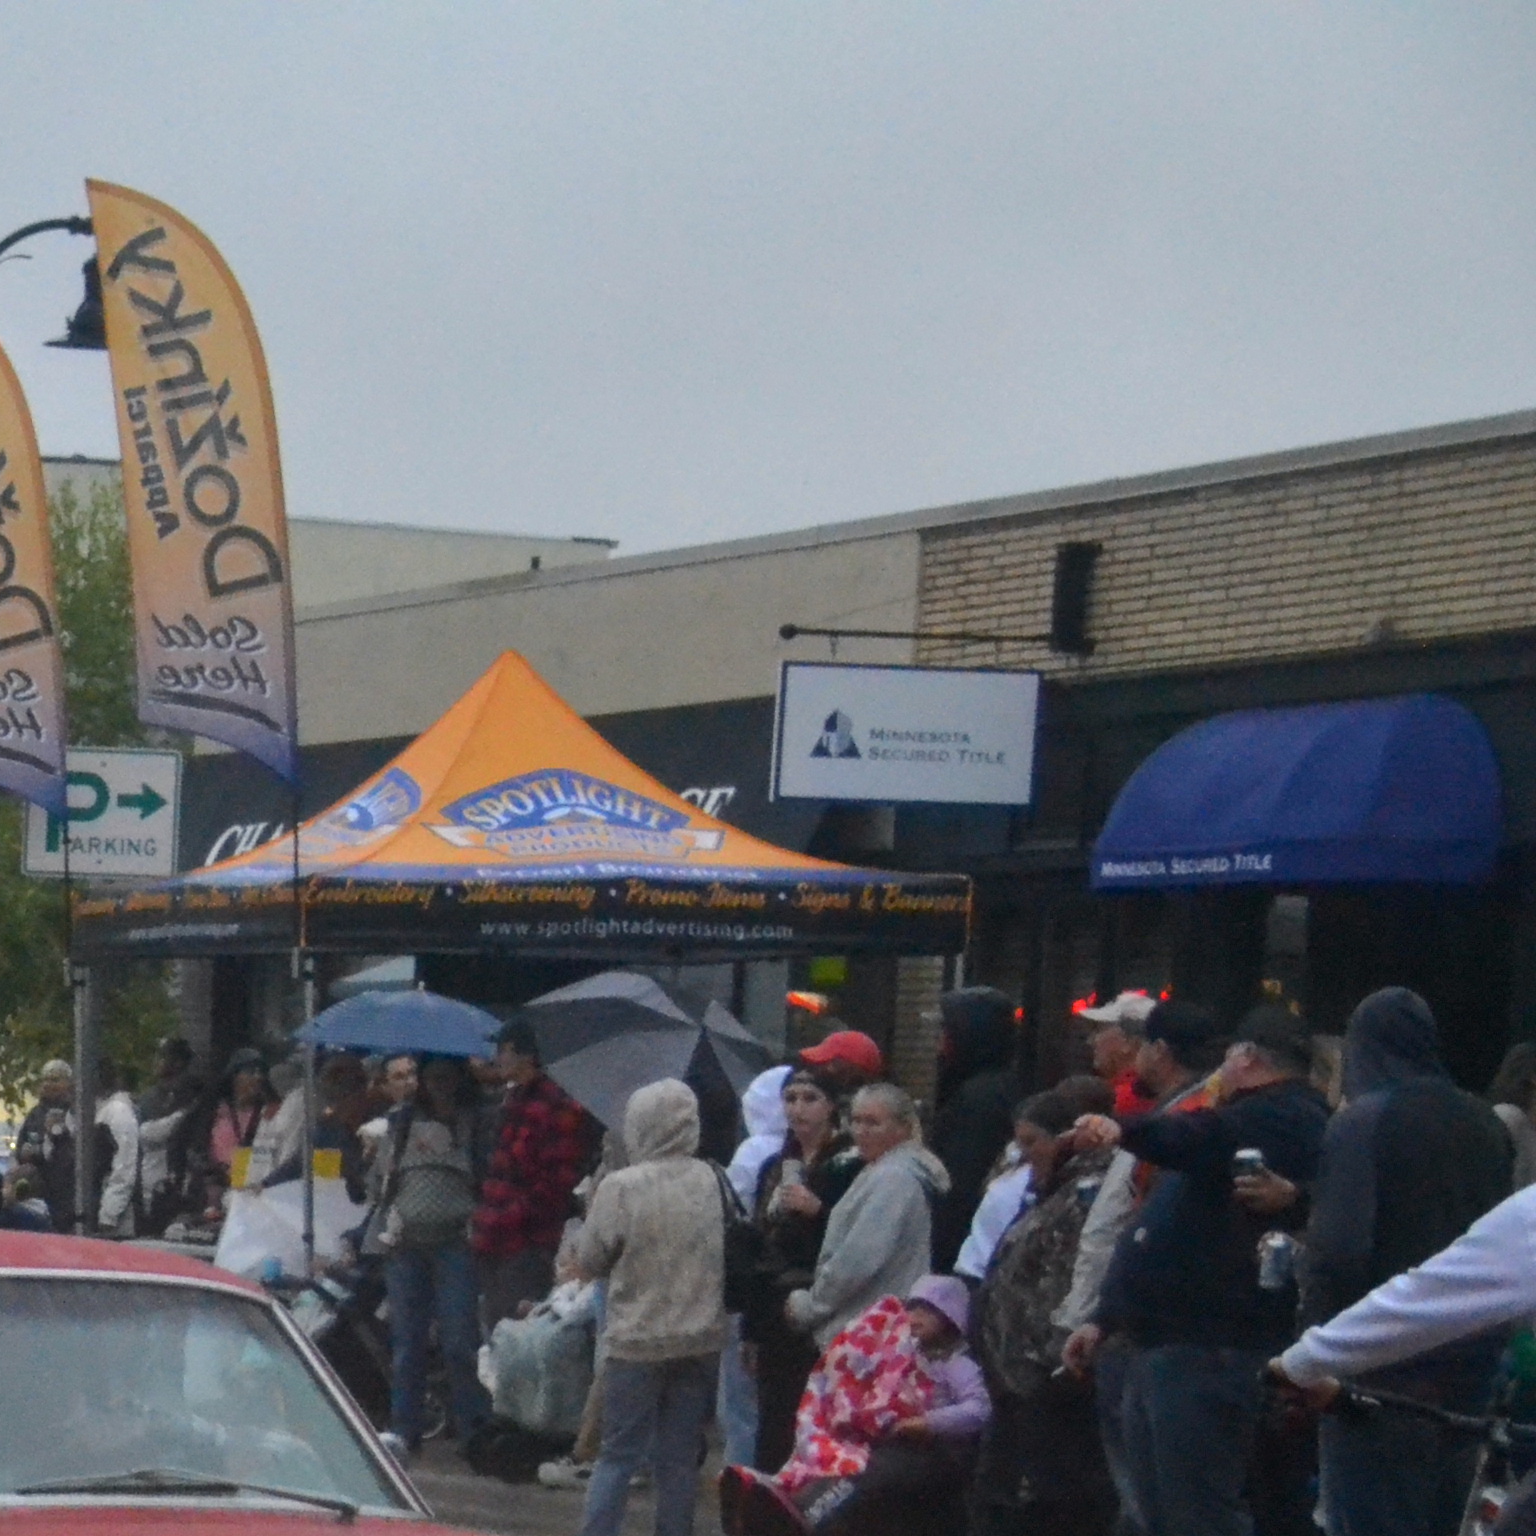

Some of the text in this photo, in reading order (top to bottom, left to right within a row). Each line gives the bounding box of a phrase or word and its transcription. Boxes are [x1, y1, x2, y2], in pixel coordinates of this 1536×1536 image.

[869, 728, 971, 744] MINNESOTA
[868, 747, 1007, 765] SECURED TITLE
[462, 777, 671, 831] SPOTLIGHT
[1234, 853, 1273, 871] TITLE
[479, 916, 794, 940] www.spotlightadvertising.com
